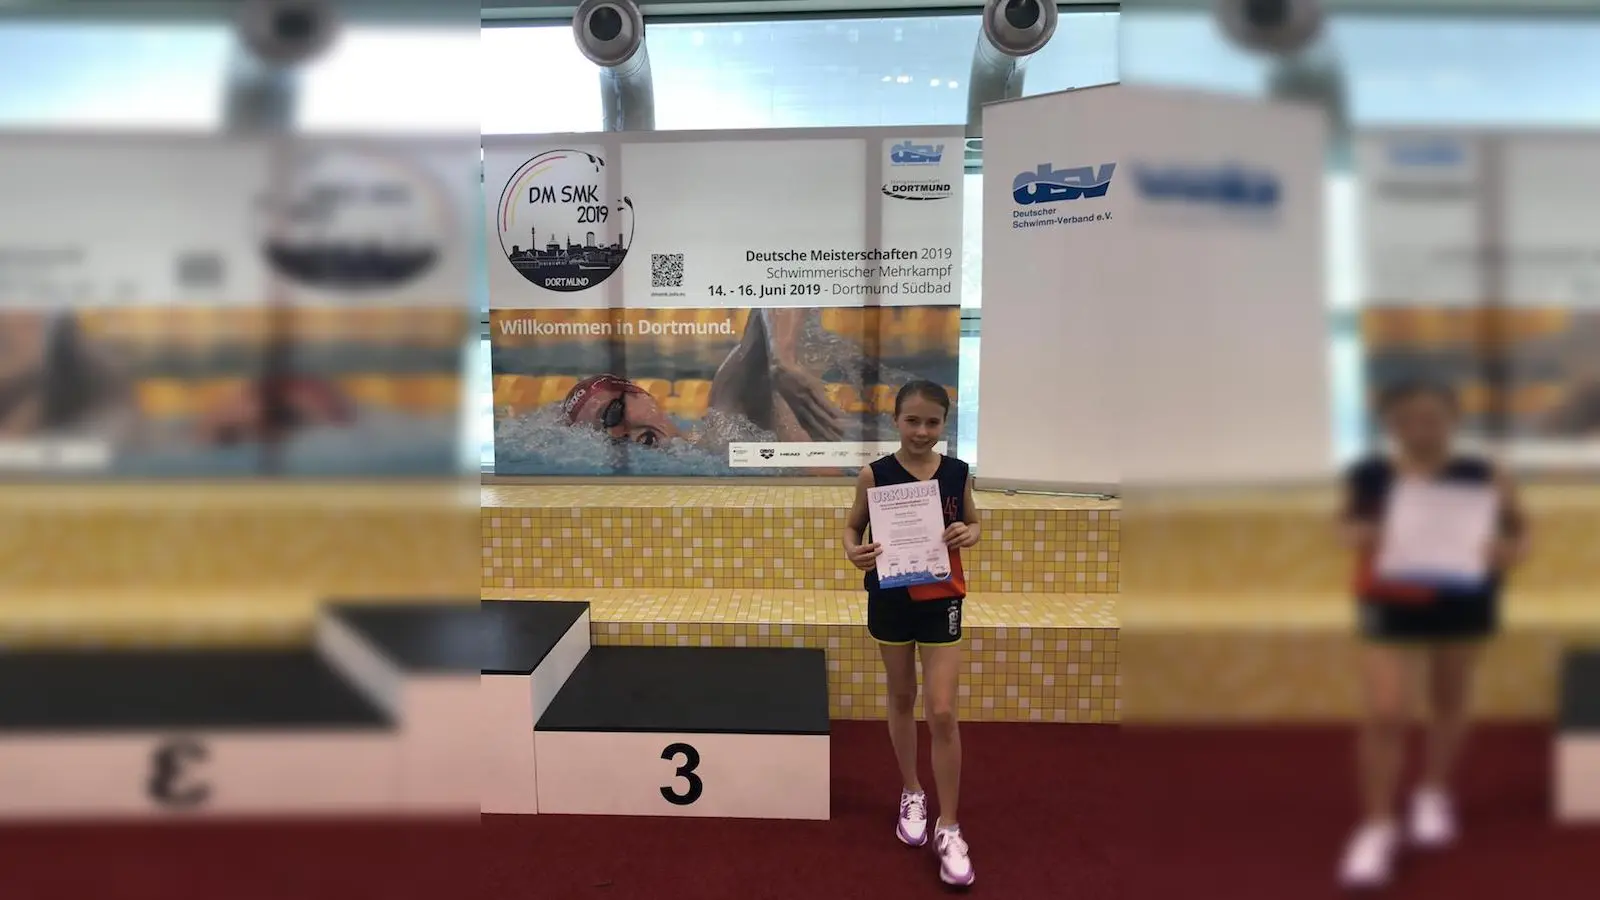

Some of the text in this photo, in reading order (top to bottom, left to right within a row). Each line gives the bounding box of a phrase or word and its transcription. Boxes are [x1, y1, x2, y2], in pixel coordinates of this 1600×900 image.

[529, 185, 599, 203] DM SMK
[892, 184, 951, 192] DORTMUND
[577, 205, 609, 223] 2019
[1012, 212, 1113, 229] Schwimm-Verband e.V.
[1013, 207, 1056, 218] Deutscher
[746, 247, 952, 262] Deutsche Meisterschaften 2019
[767, 264, 953, 279] Schwimmerischer Mehrkampf
[545, 277, 589, 287] DORTMUND
[708, 285, 727, 296] 14.
[738, 284, 757, 296] 16.
[758, 284, 786, 298] Juni
[790, 284, 820, 295] 2019
[832, 282, 898, 295] Dortmund
[902, 281, 951, 294] Südbad
[499, 319, 736, 335] Willkommen in Dortmund.
[873, 484, 937, 503] URKUNDE
[660, 742, 703, 805] 3
